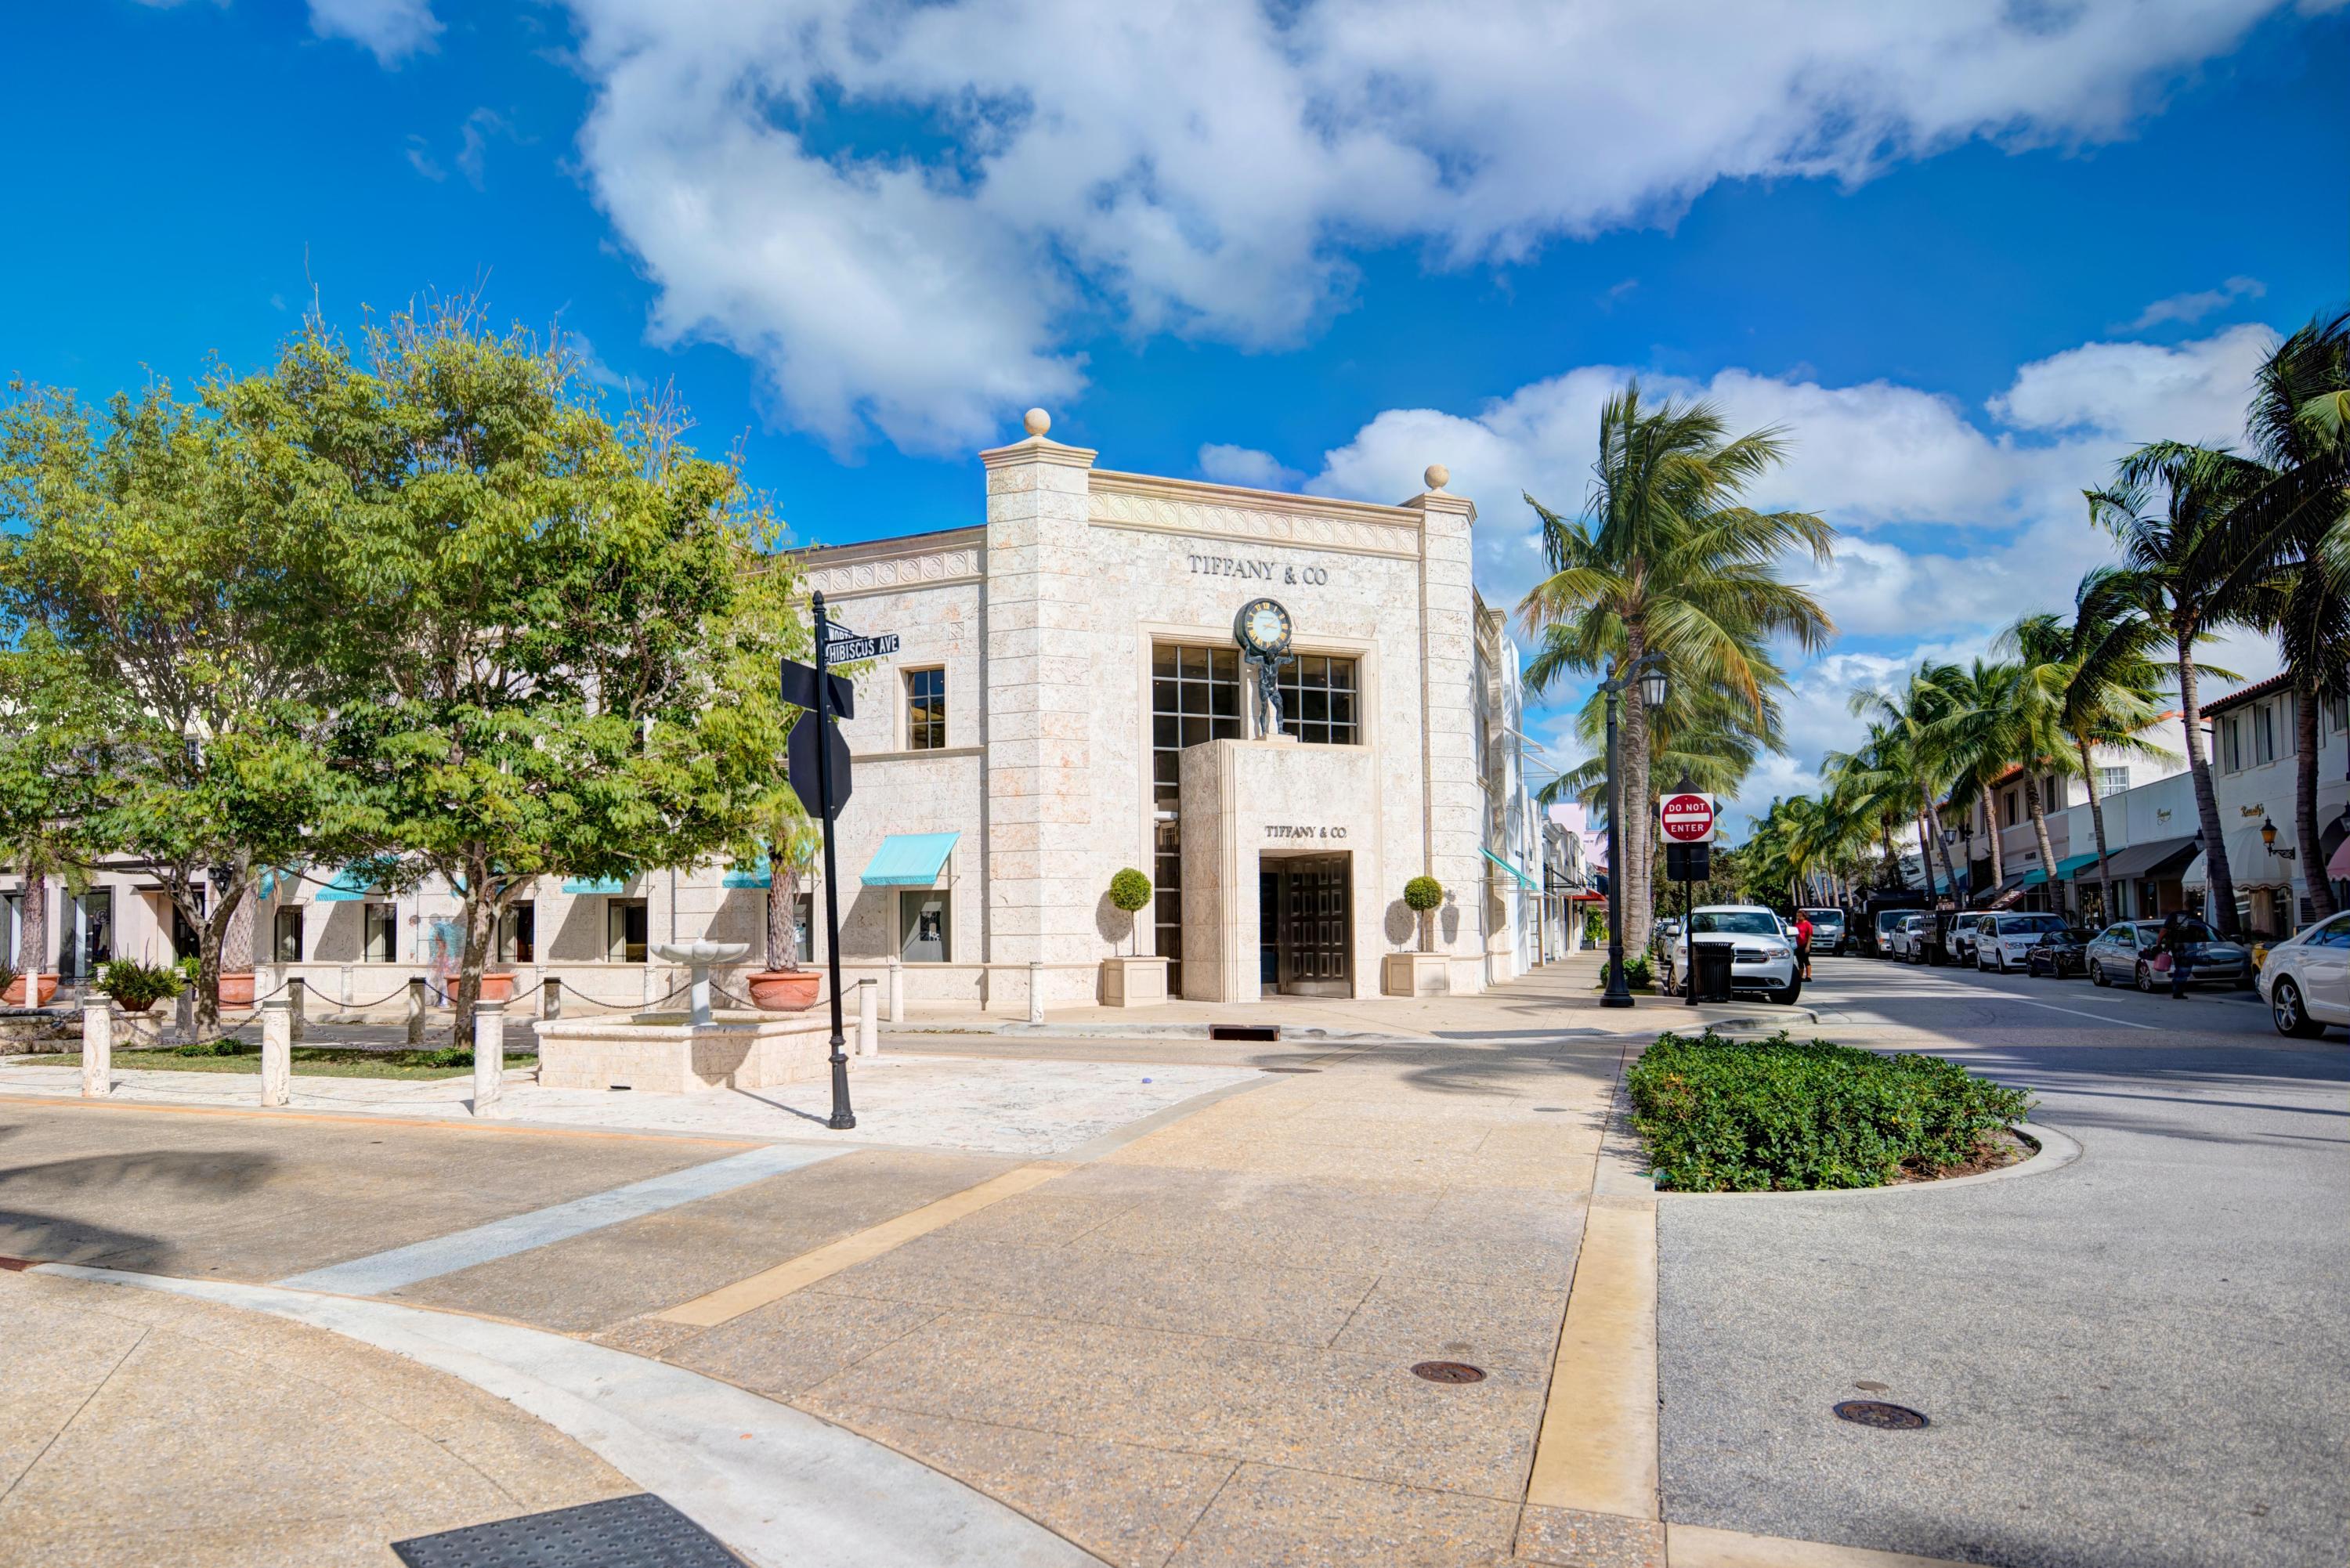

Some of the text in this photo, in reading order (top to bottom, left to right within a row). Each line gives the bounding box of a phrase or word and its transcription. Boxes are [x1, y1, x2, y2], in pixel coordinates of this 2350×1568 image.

[1188, 555, 1329, 585] TIFFANY & CO
[830, 634, 898, 663] HIBISCUS AVE
[1668, 803, 1705, 812] DO NOT
[1265, 825, 1316, 839] TIFFANY
[1319, 826, 1328, 839] &
[1671, 824, 1704, 833] ENTER
